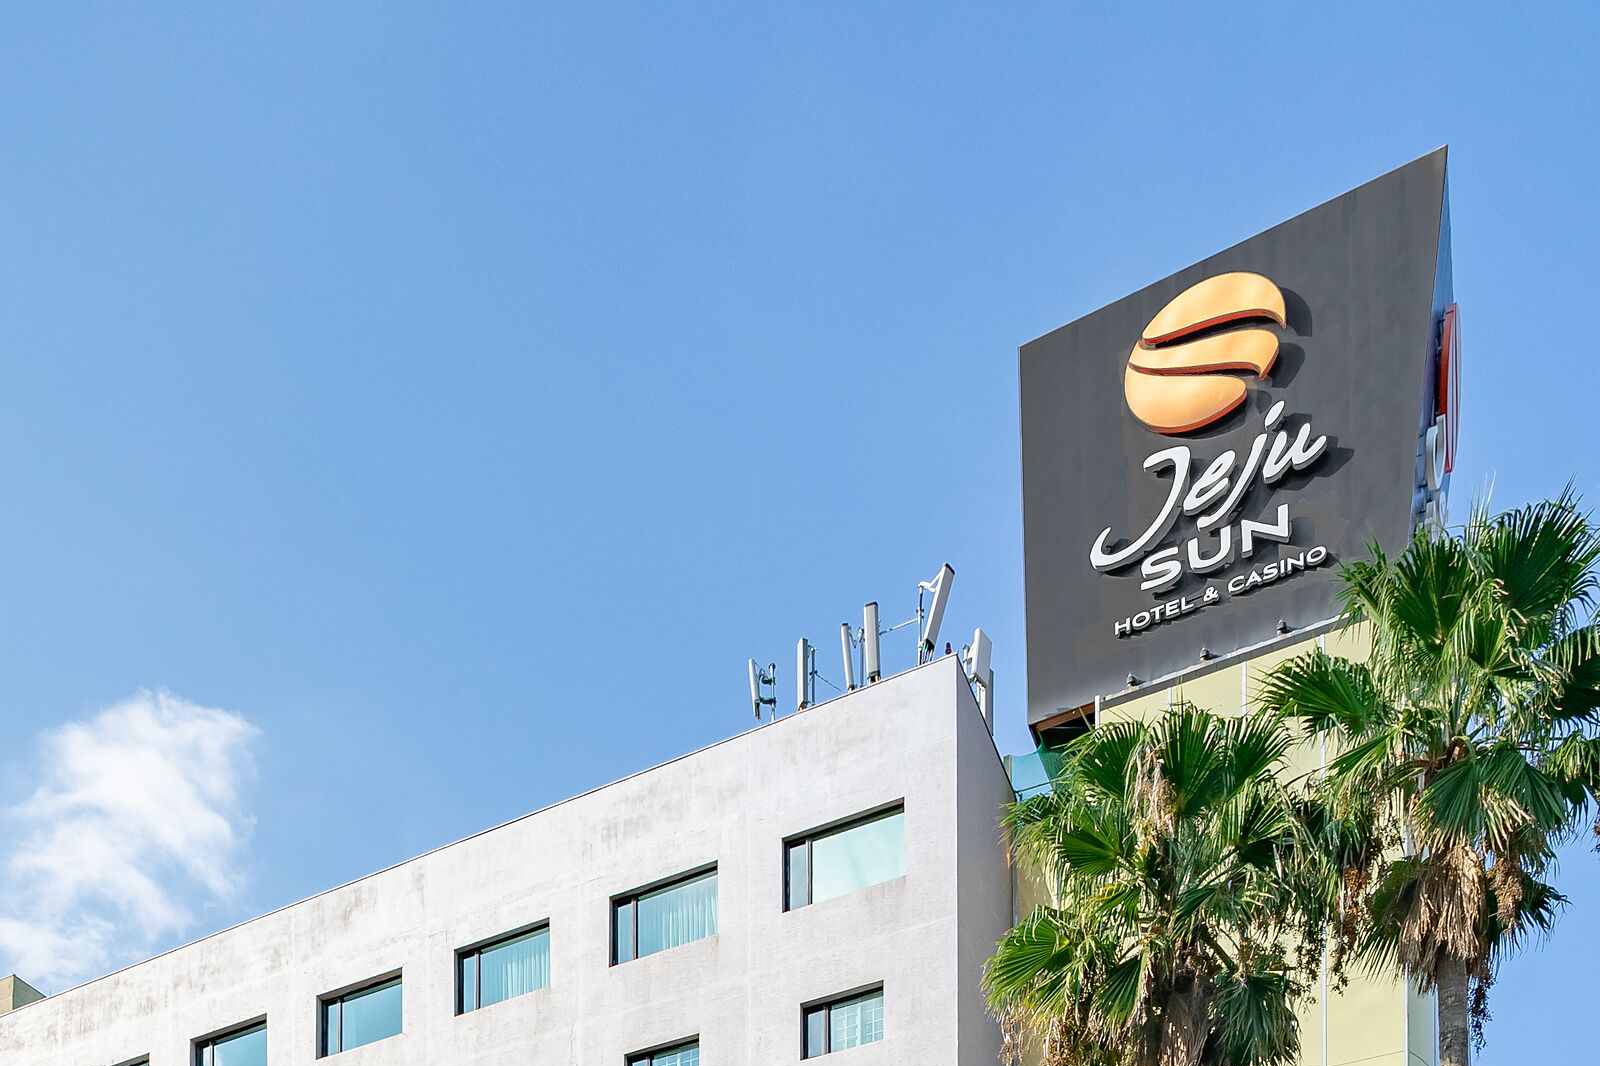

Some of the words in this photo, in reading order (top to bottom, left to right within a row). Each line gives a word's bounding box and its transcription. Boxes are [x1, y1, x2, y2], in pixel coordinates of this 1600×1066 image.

[1090, 400, 1327, 572] Jeju
[1114, 597, 1195, 637] HOTEL
[1203, 586, 1219, 603] &
[1227, 545, 1327, 595] CASINO
[1140, 503, 1292, 592] SUN
